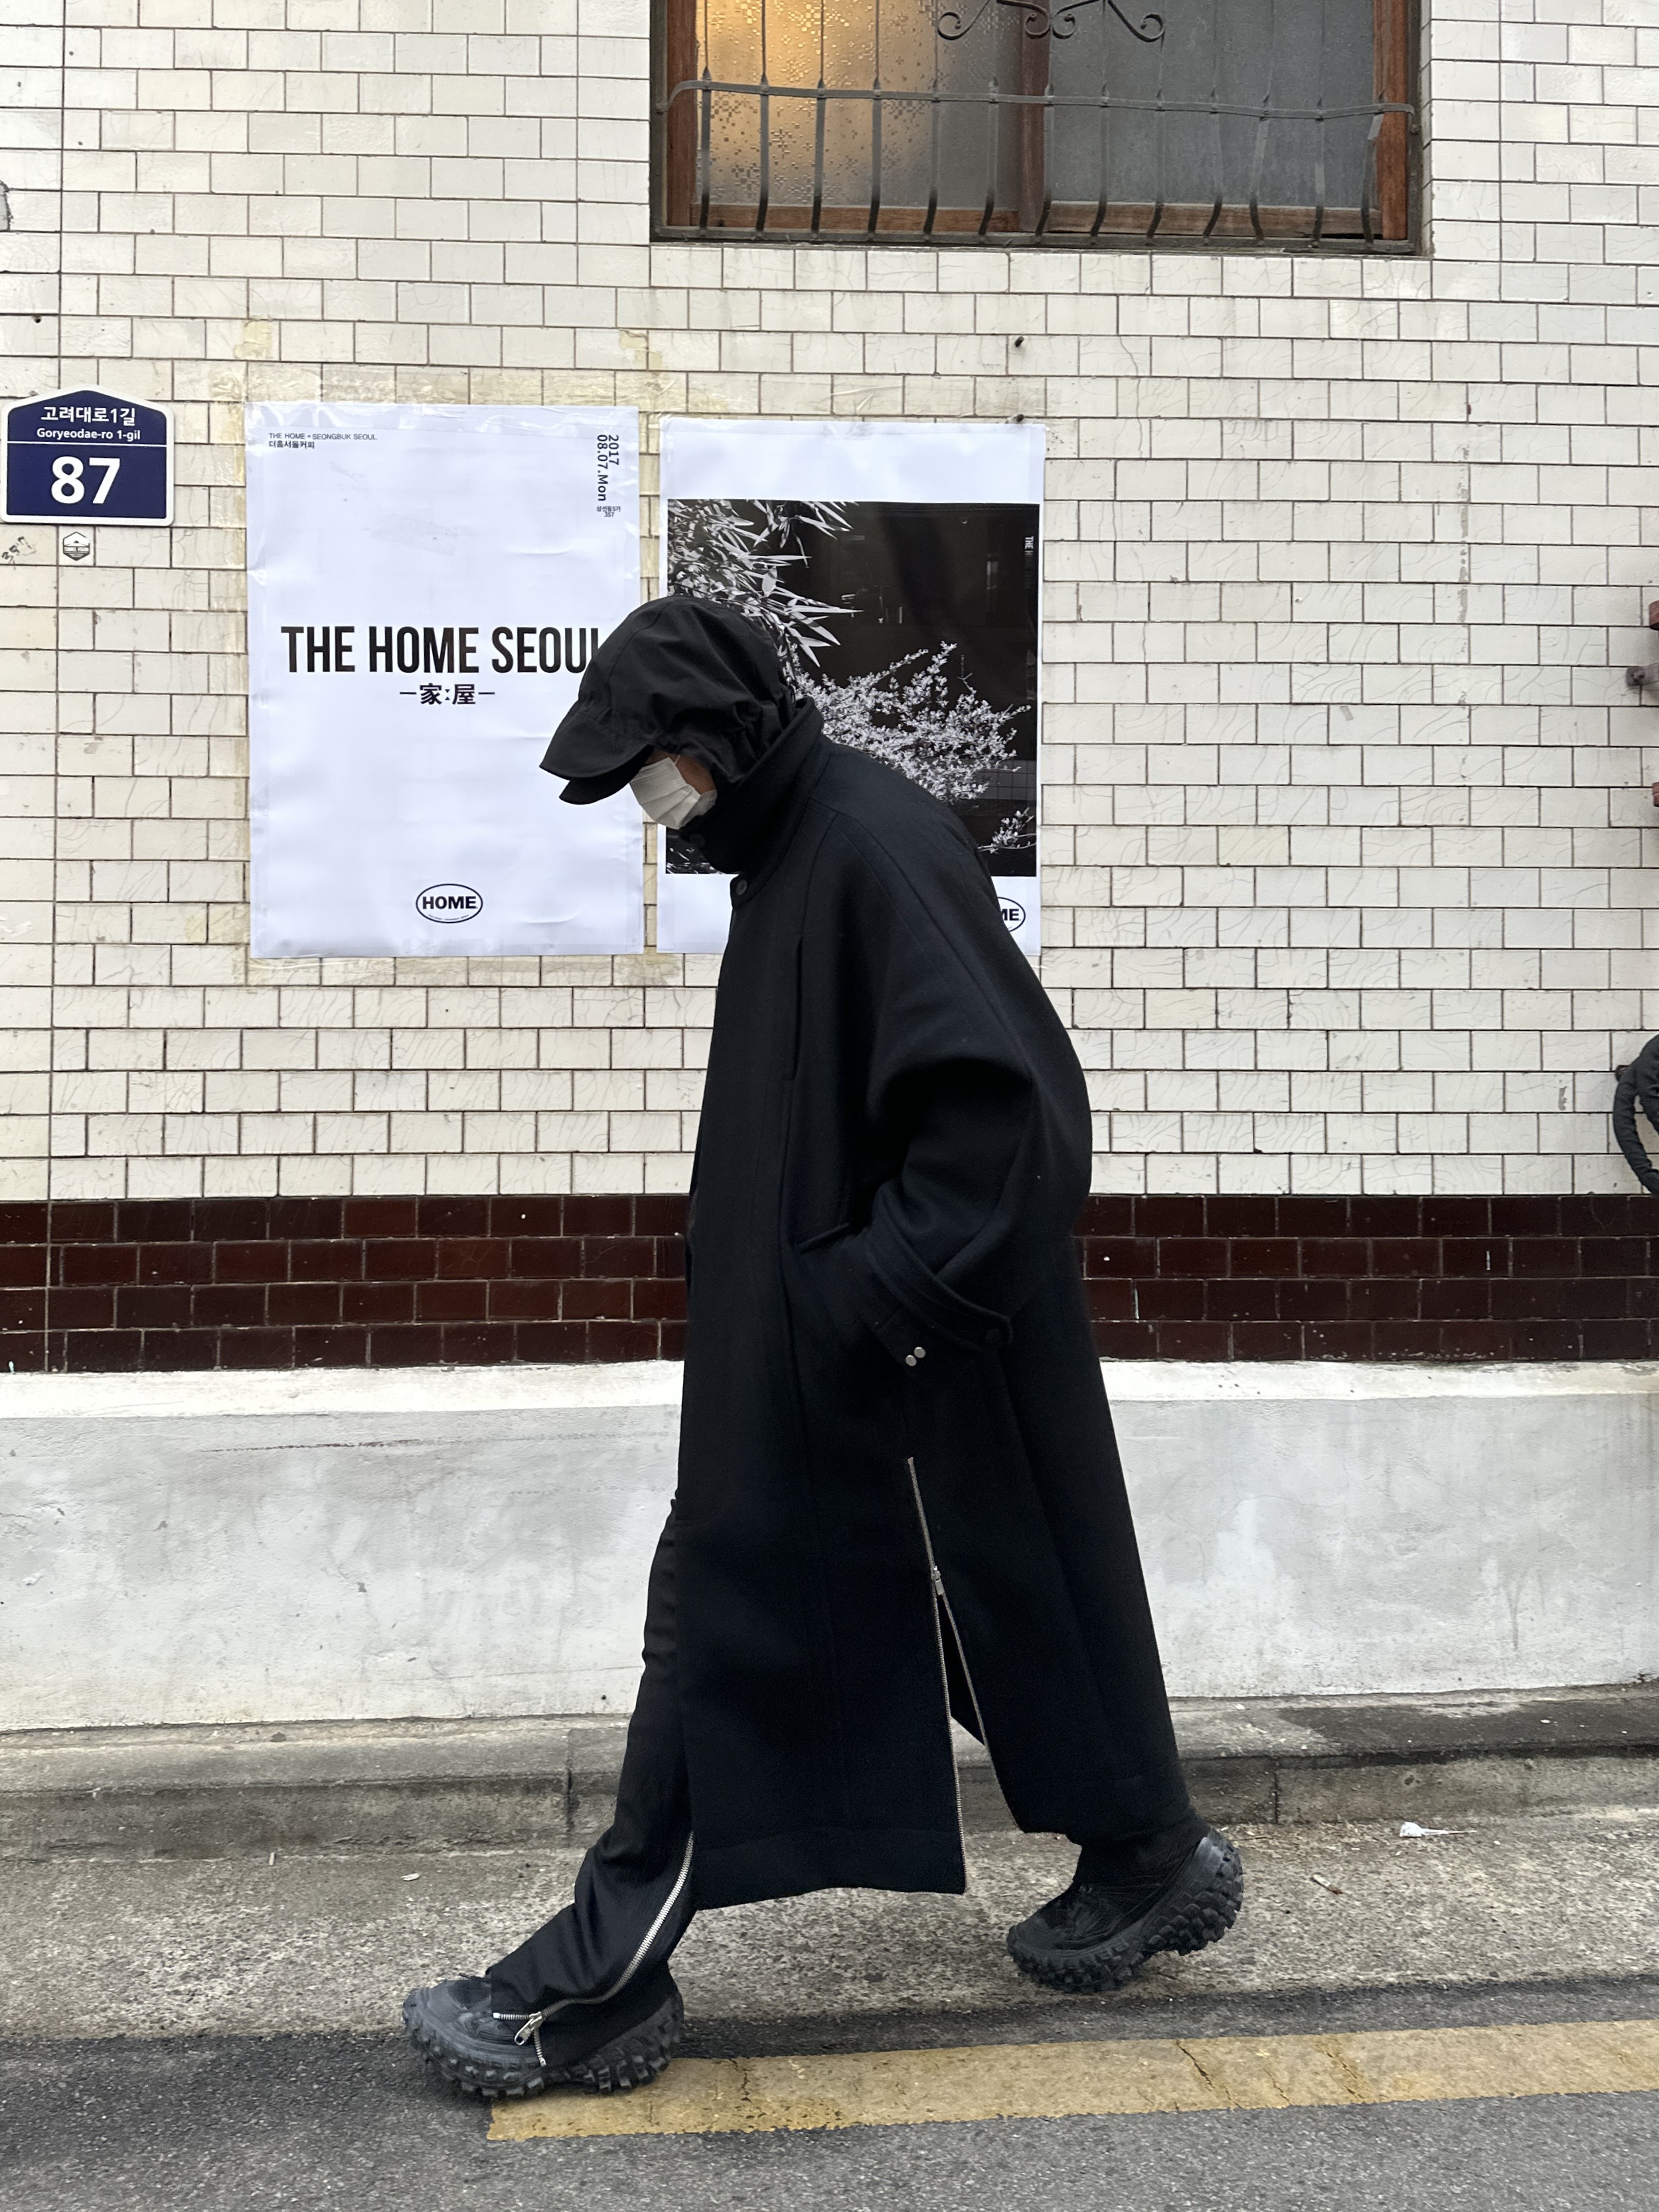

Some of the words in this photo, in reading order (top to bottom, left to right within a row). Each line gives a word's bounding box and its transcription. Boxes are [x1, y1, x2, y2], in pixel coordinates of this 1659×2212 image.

[40, 406, 135, 426] 고려대로1길
[37, 428, 114, 441] Goryeodae-ro
[117, 430, 141, 442] 1-gil
[609, 434, 619, 465] 2017
[50, 456, 120, 504] 87
[597, 434, 608, 501] 08.07.Mon
[281, 626, 355, 673] THE
[369, 626, 479, 674] HOME
[422, 895, 477, 909] HOME
